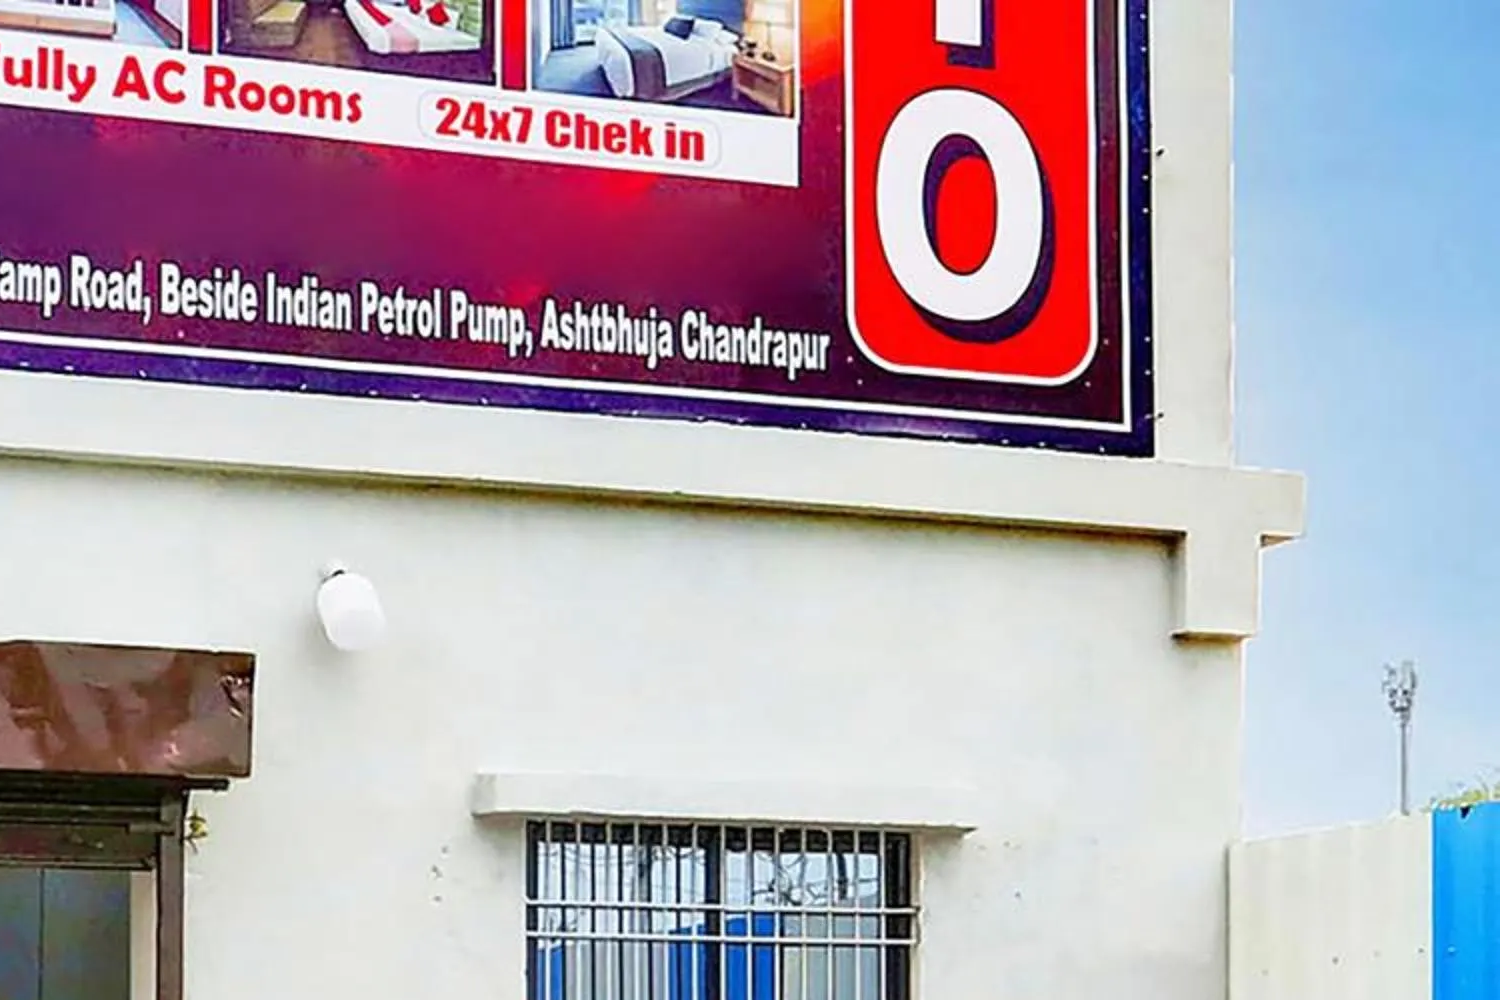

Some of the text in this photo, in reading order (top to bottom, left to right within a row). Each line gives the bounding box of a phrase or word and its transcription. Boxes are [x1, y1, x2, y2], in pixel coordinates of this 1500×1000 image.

[111, 55, 187, 105] AC
[202, 65, 363, 124] Rooms
[434, 96, 706, 163] 24x7 Chek in
[69, 254, 152, 326] Road,
[160, 262, 257, 323] Beside
[265, 271, 353, 333] Indian
[359, 281, 442, 340] Petrol
[450, 289, 534, 358] Pump,
[540, 298, 675, 371] Ashtbhuja
[680, 309, 831, 381] Chandrapur
